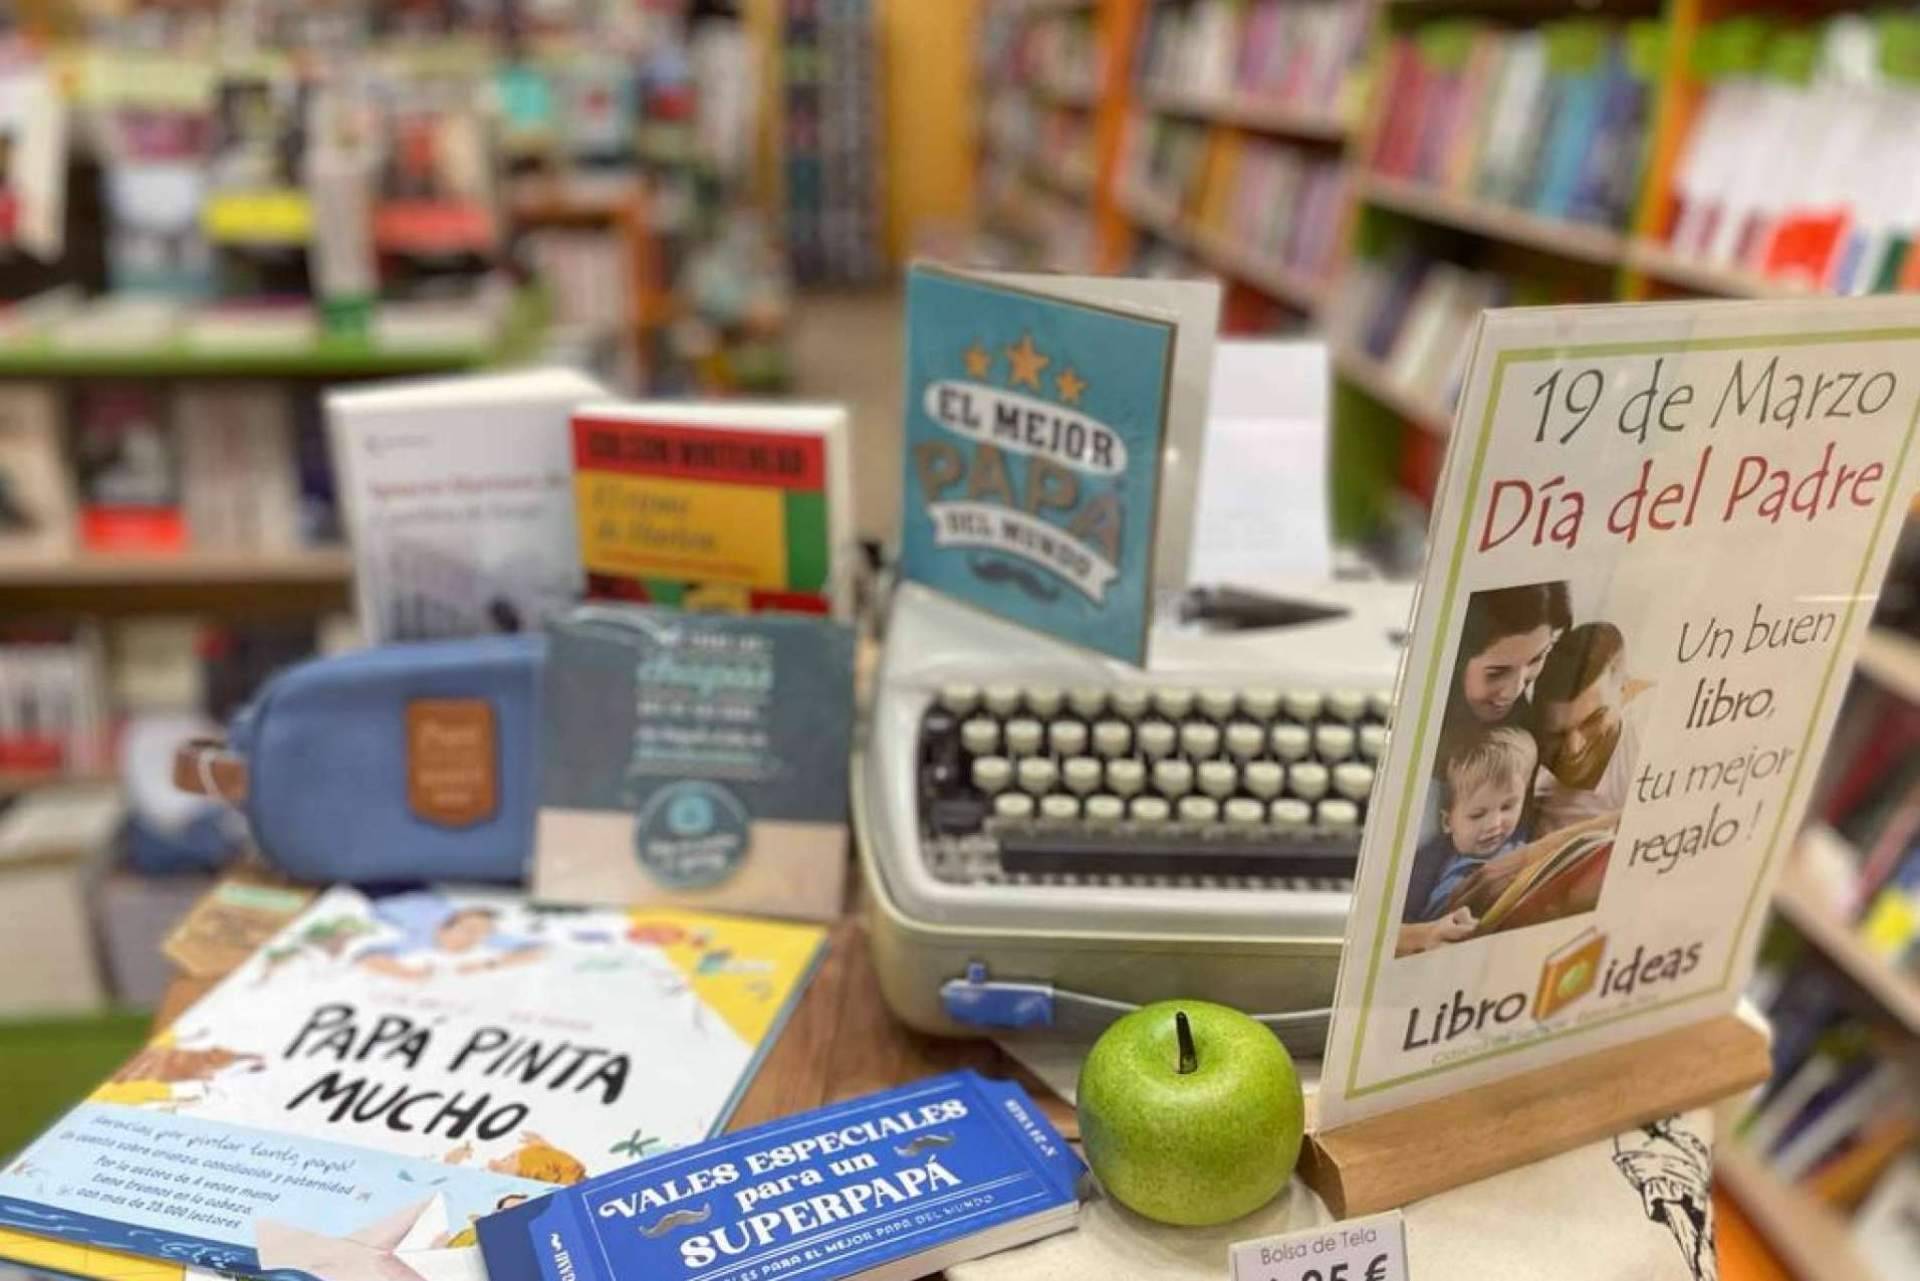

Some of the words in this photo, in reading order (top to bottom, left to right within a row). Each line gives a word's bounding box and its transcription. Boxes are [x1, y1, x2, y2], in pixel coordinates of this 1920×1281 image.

[938, 387, 979, 427] EL
[992, 402, 1114, 468] MEJOR
[1533, 368, 1604, 445] 19
[1618, 357, 1693, 443] de
[1709, 355, 1897, 431] Marzo
[1478, 475, 1585, 552] Día
[1607, 445, 1713, 544] del
[1722, 442, 1884, 523] Padre
[1677, 617, 1734, 664] Un
[1743, 603, 1836, 654] buen
[1637, 763, 1676, 803] tu
[1685, 746, 1794, 797] mejor
[1402, 989, 1527, 1052] Libro
[1600, 941, 1702, 998] ideas
[283, 1002, 447, 1070] PAPÁ
[447, 1026, 631, 1104] PINTA
[285, 1071, 529, 1141] MUCHO
[95, 1154, 117, 1168] Por
[129, 1165, 173, 1181] autora
[174, 1173, 191, 1184] de
[282, 1174, 356, 1196] paternidad
[599, 1162, 740, 1218] VALES
[745, 1098, 968, 1177] ESPECIALES
[735, 1168, 824, 1213] para
[831, 1152, 878, 1177] un
[128, 1197, 145, 1209] de
[679, 1155, 962, 1269] SUPERPAPÁ
[761, 1254, 802, 1275] PARA
[804, 1247, 823, 1261] EL
[825, 1230, 873, 1253] MEJOR
[1261, 1241, 1308, 1265] Bolsa
[1312, 1235, 1336, 1255] de
[1341, 1227, 1377, 1249] Tela
